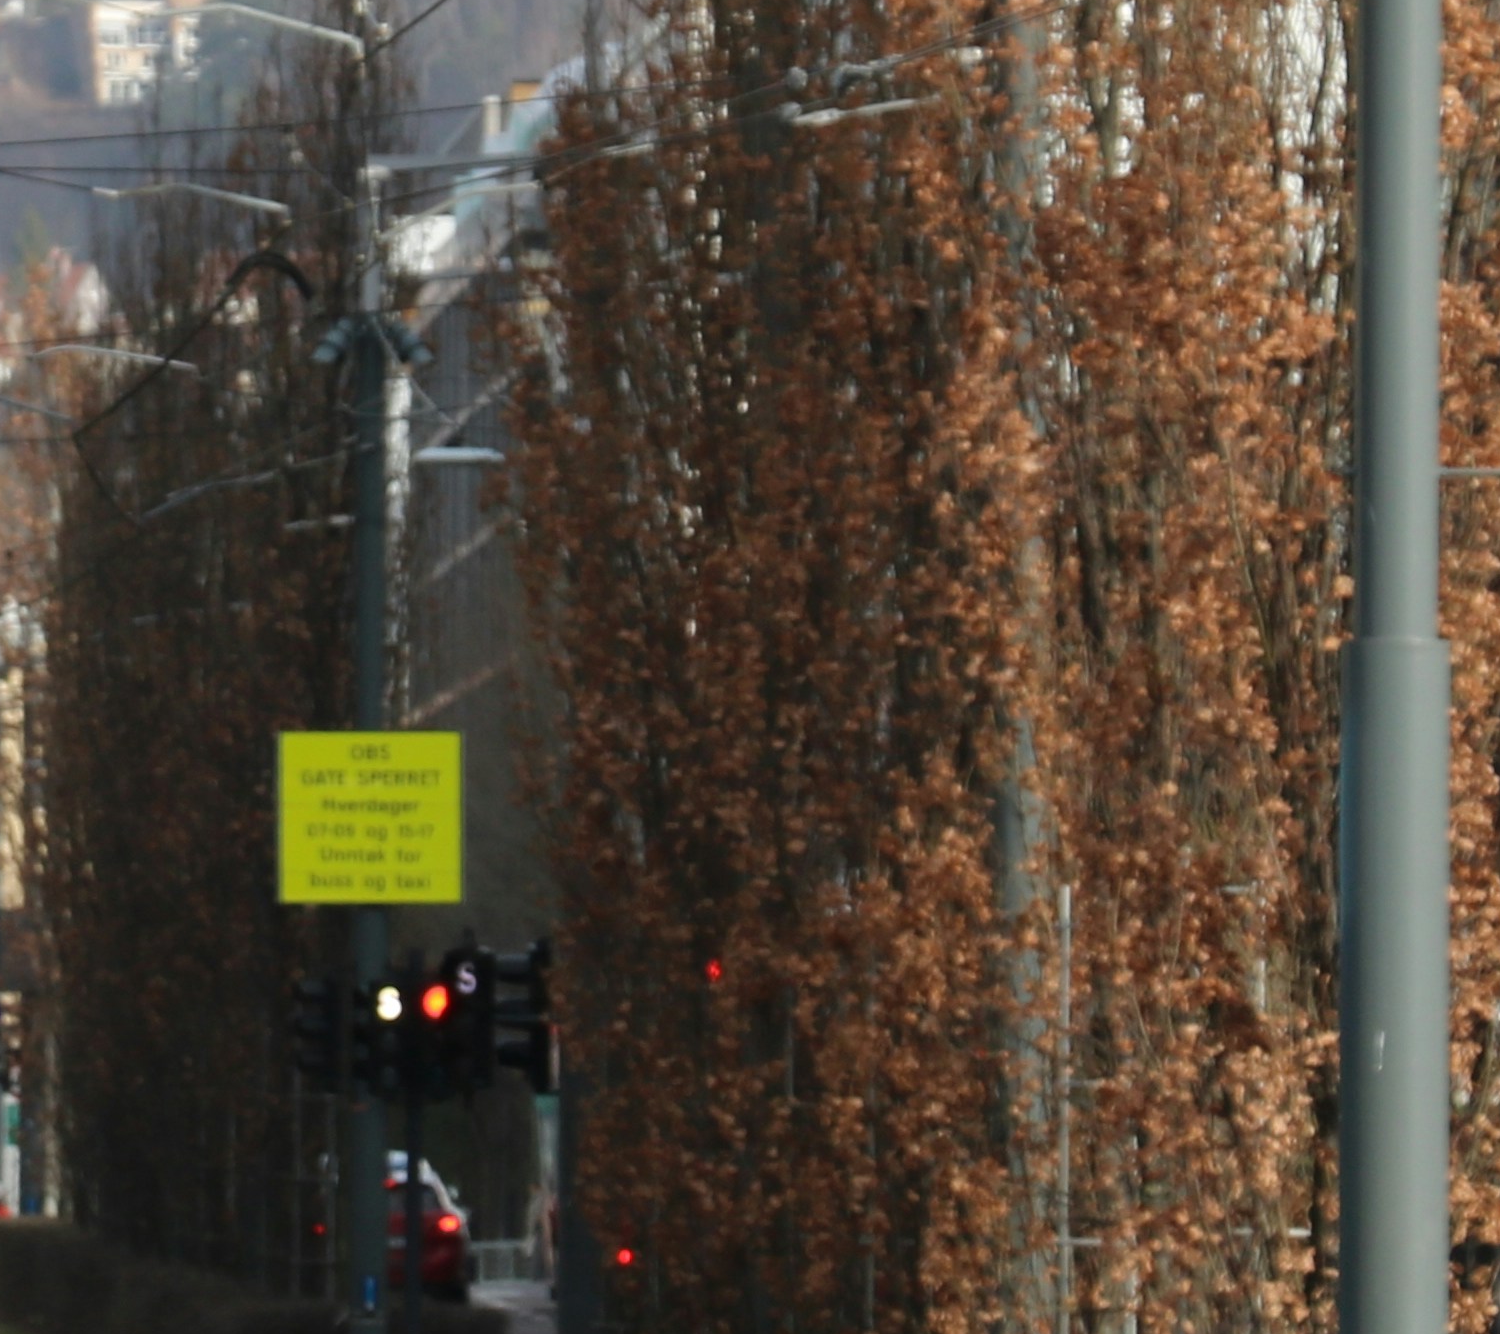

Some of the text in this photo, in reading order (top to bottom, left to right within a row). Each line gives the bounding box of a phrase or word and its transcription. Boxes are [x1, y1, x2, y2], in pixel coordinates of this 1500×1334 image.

[350, 744, 391, 761] OBS
[301, 769, 441, 787] GATE SPERRET
[321, 798, 420, 817] Hverdager
[365, 826, 389, 843] og
[320, 846, 421, 864] Unntak for
[310, 873, 431, 893] buss og taxi
